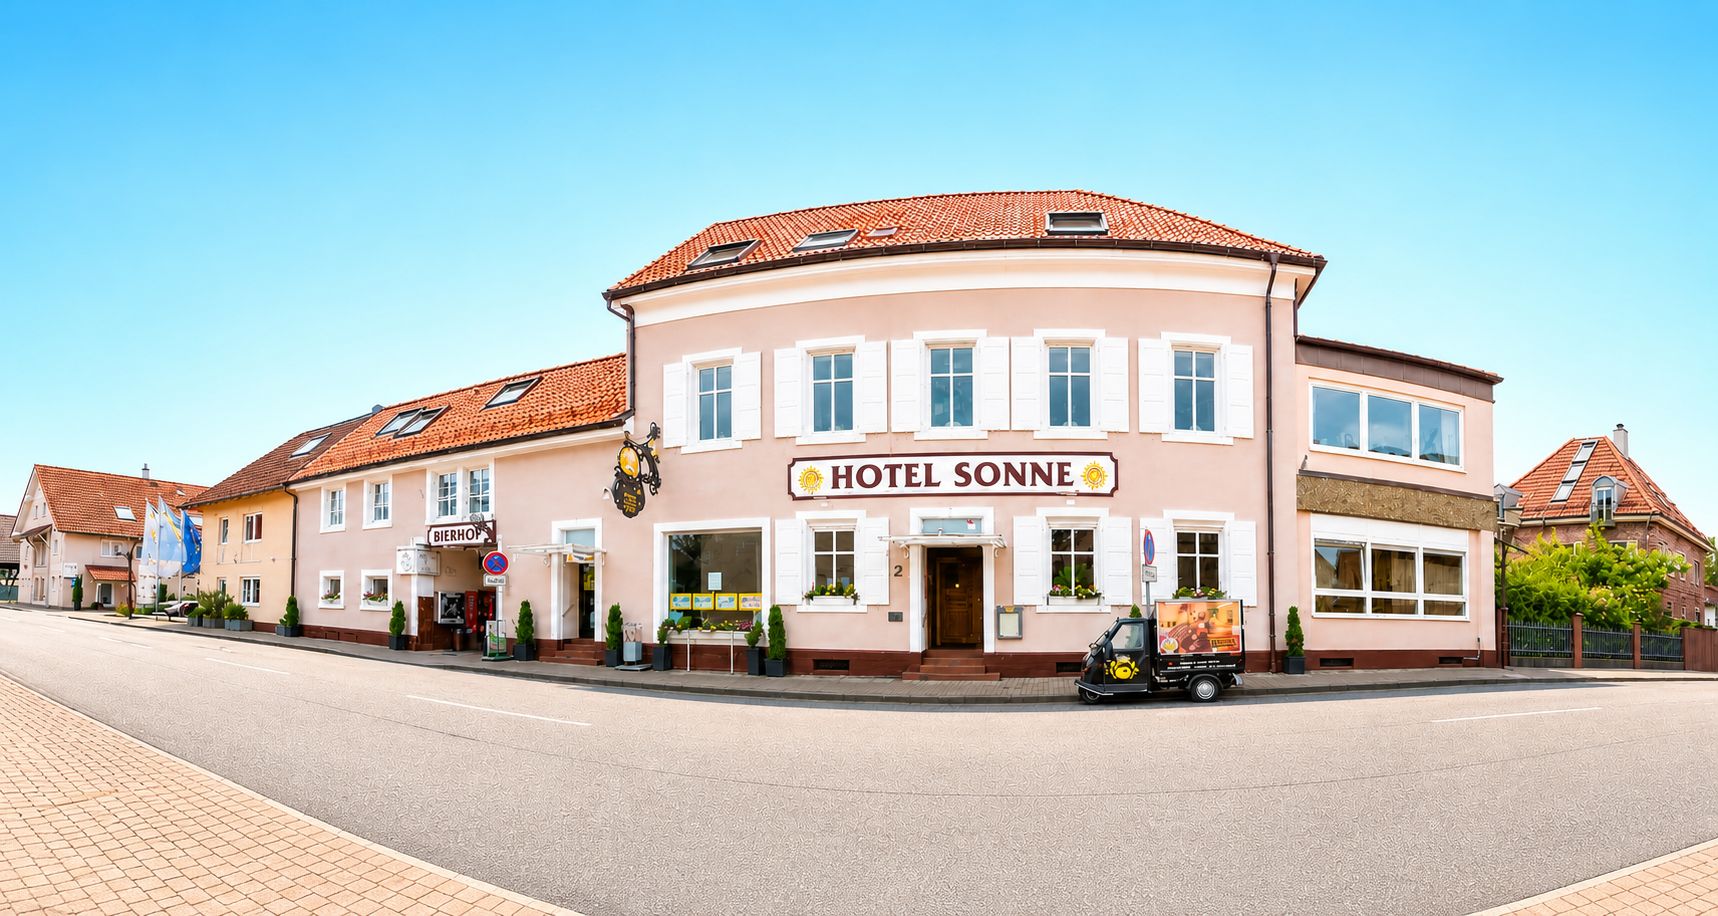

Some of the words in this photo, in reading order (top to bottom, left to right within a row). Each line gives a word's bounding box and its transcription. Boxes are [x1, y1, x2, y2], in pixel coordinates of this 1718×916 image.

[831, 463, 942, 489] HOTEL
[954, 461, 1074, 487] SONNE
[894, 564, 903, 577] 2
